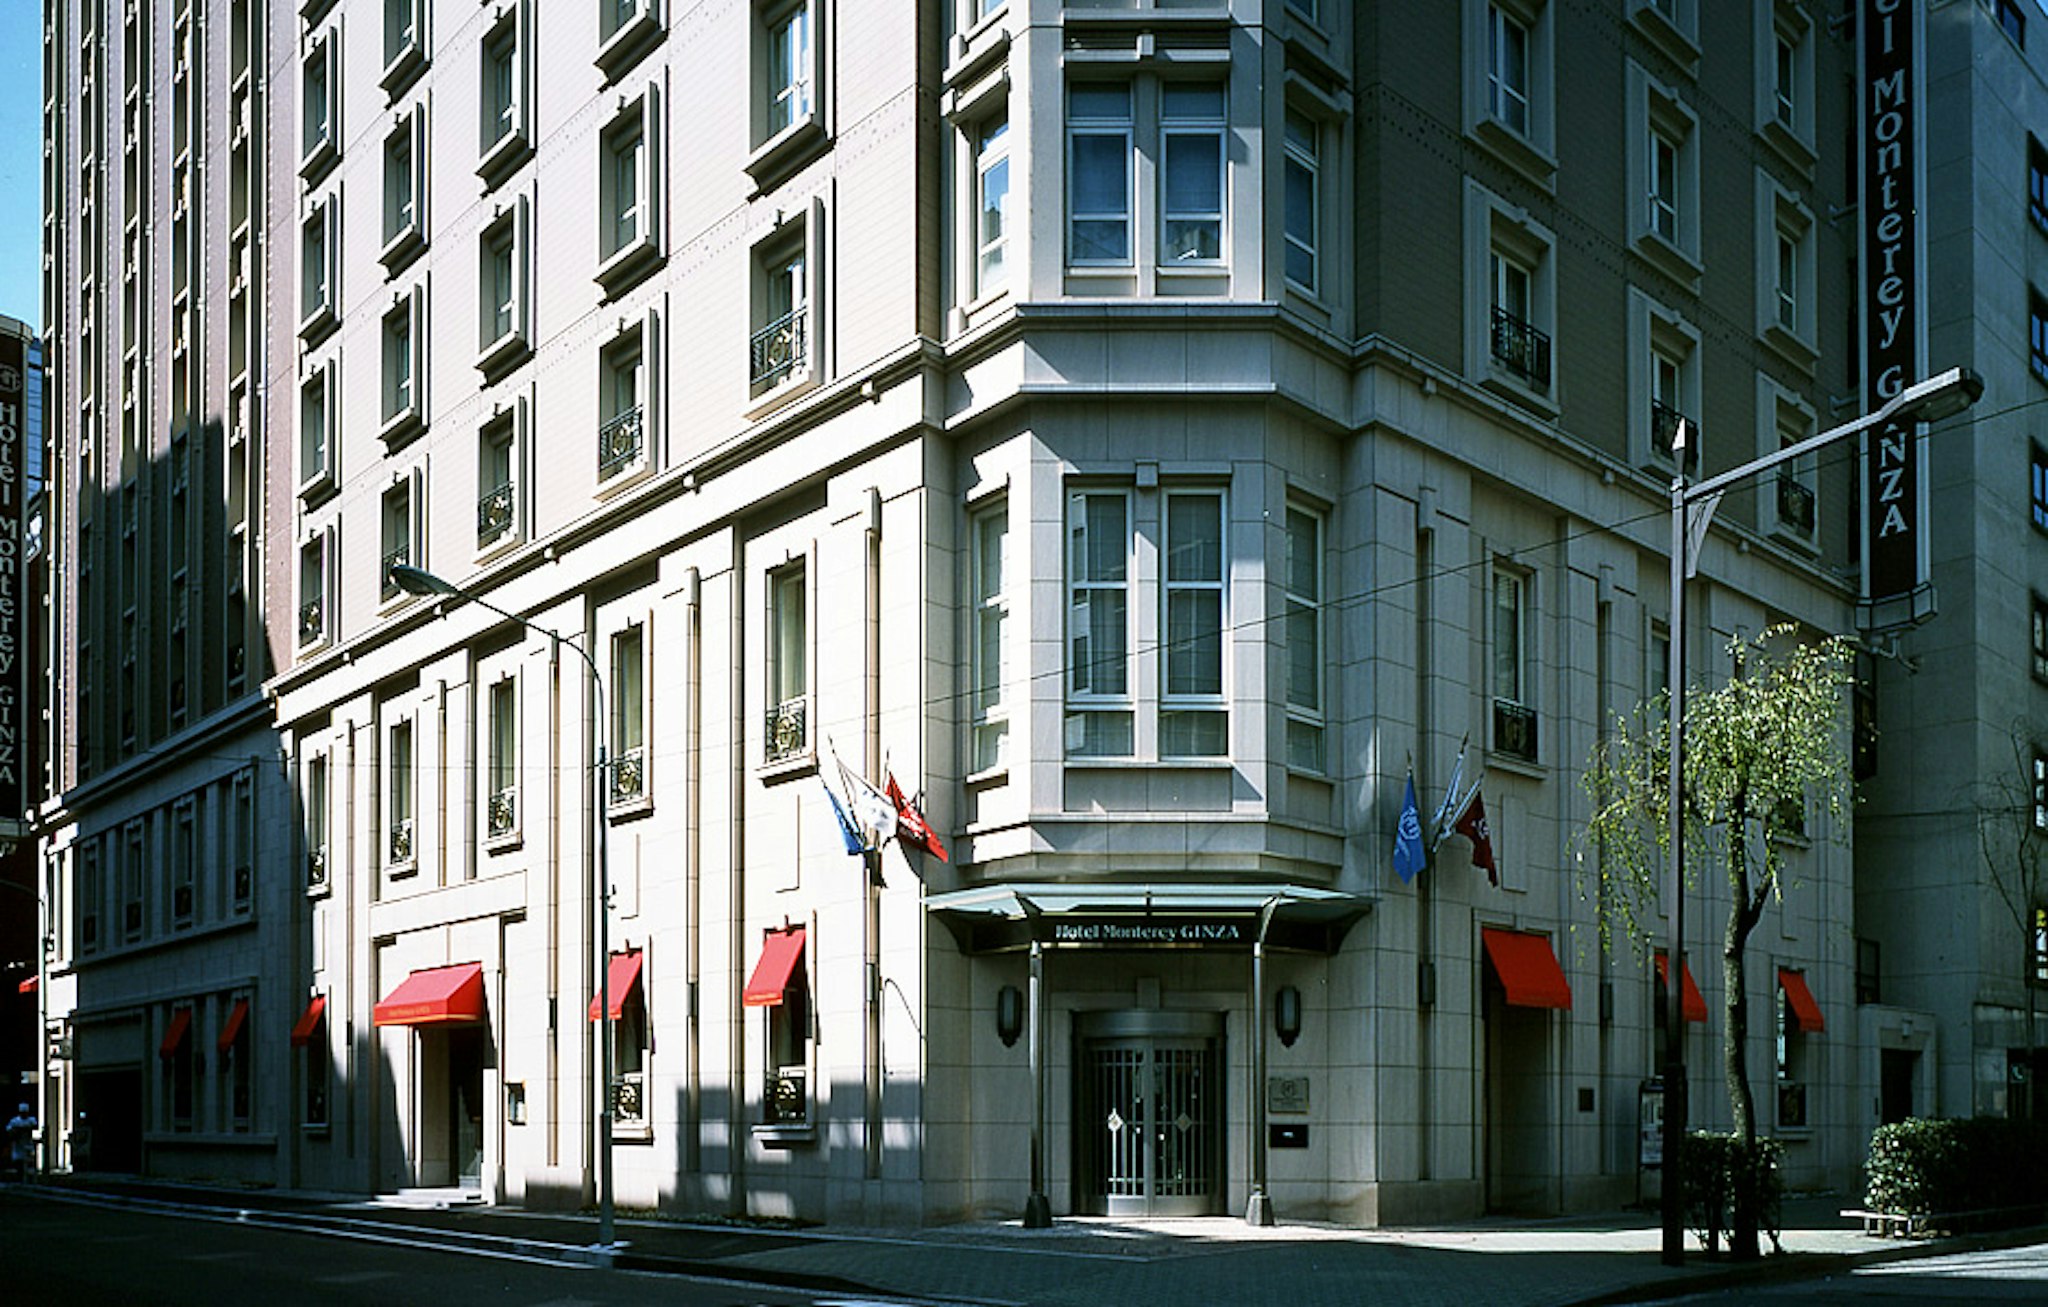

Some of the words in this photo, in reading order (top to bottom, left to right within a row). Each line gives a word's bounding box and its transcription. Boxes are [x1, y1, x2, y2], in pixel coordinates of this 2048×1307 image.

[1872, 68, 1906, 350] Monterey
[1876, 364, 1908, 538] GNZA
[1055, 924, 1099, 939] Hotel
[1103, 924, 1177, 942] Monterey
[1180, 924, 1240, 939] GINZA
